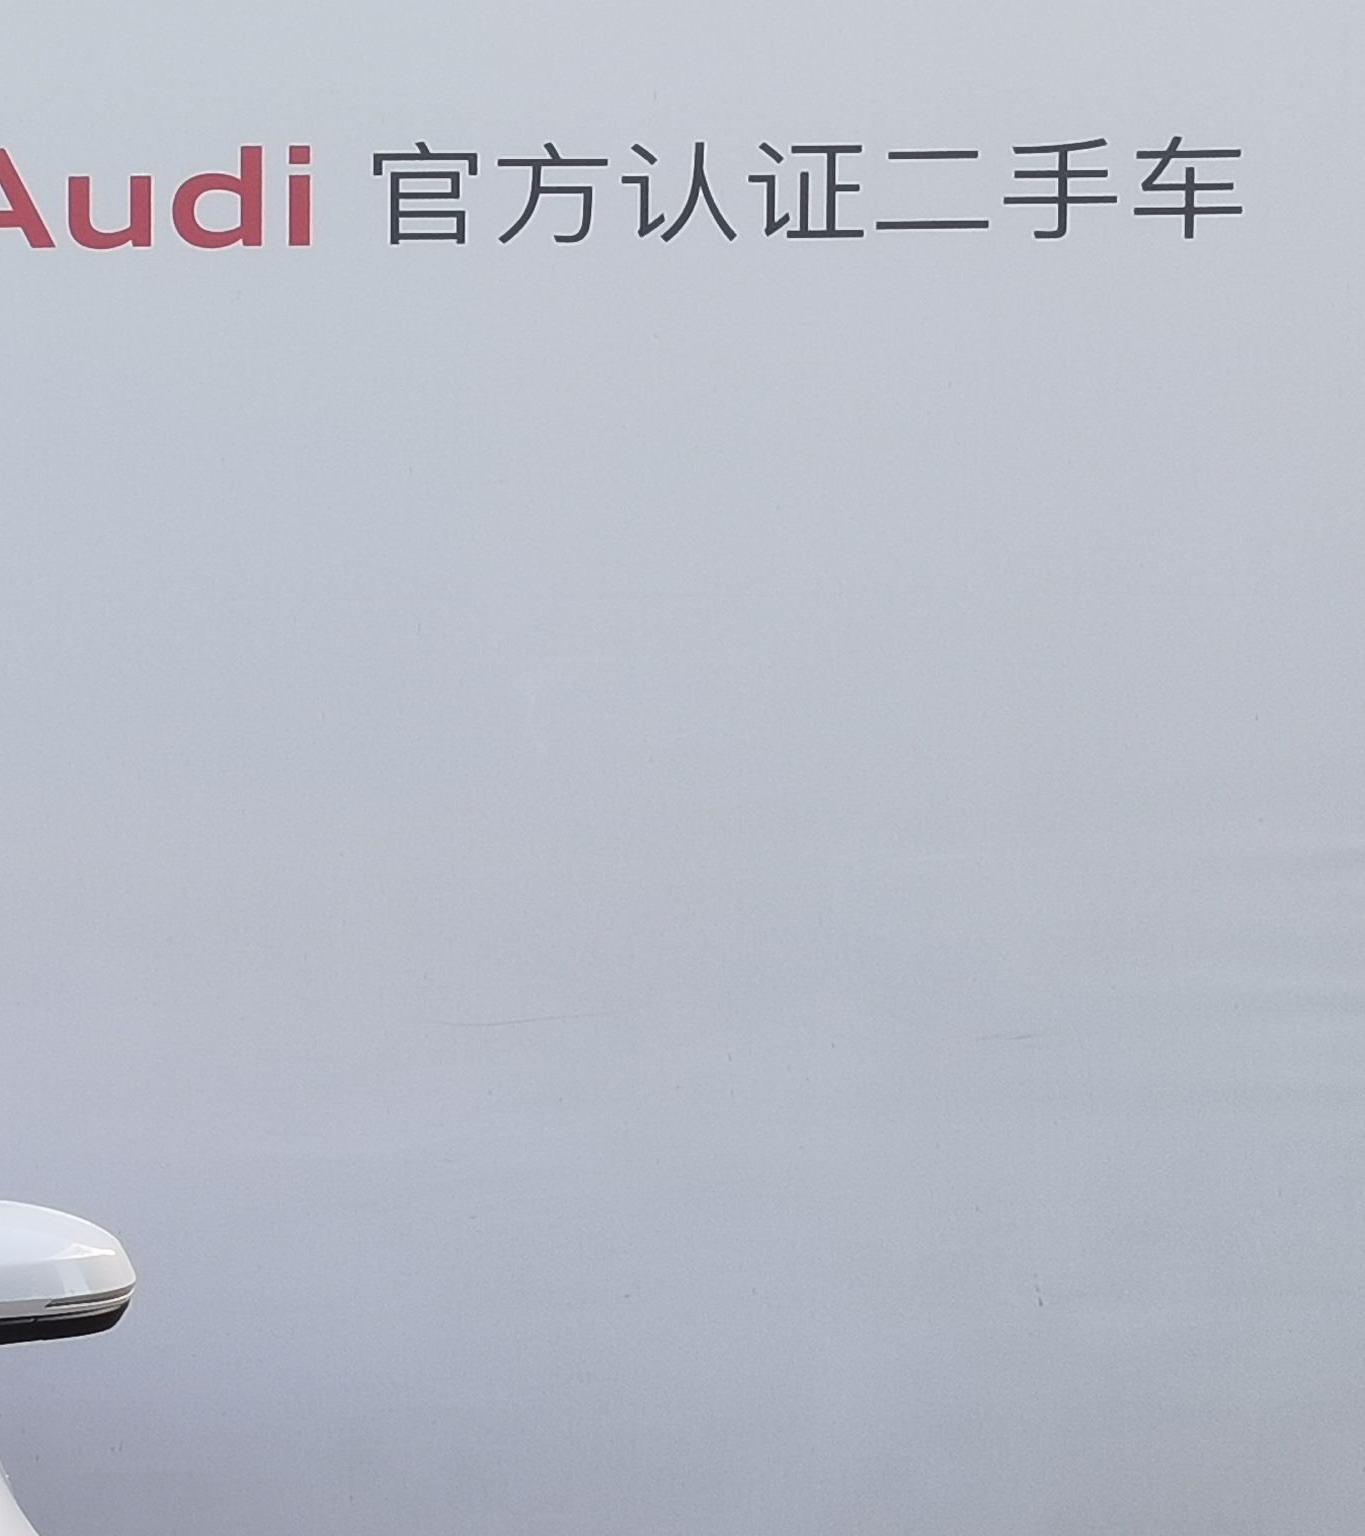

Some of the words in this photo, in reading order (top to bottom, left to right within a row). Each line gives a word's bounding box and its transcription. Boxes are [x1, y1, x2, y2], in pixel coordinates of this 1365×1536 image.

[372, 136, 1244, 245] 官方认证二手车
